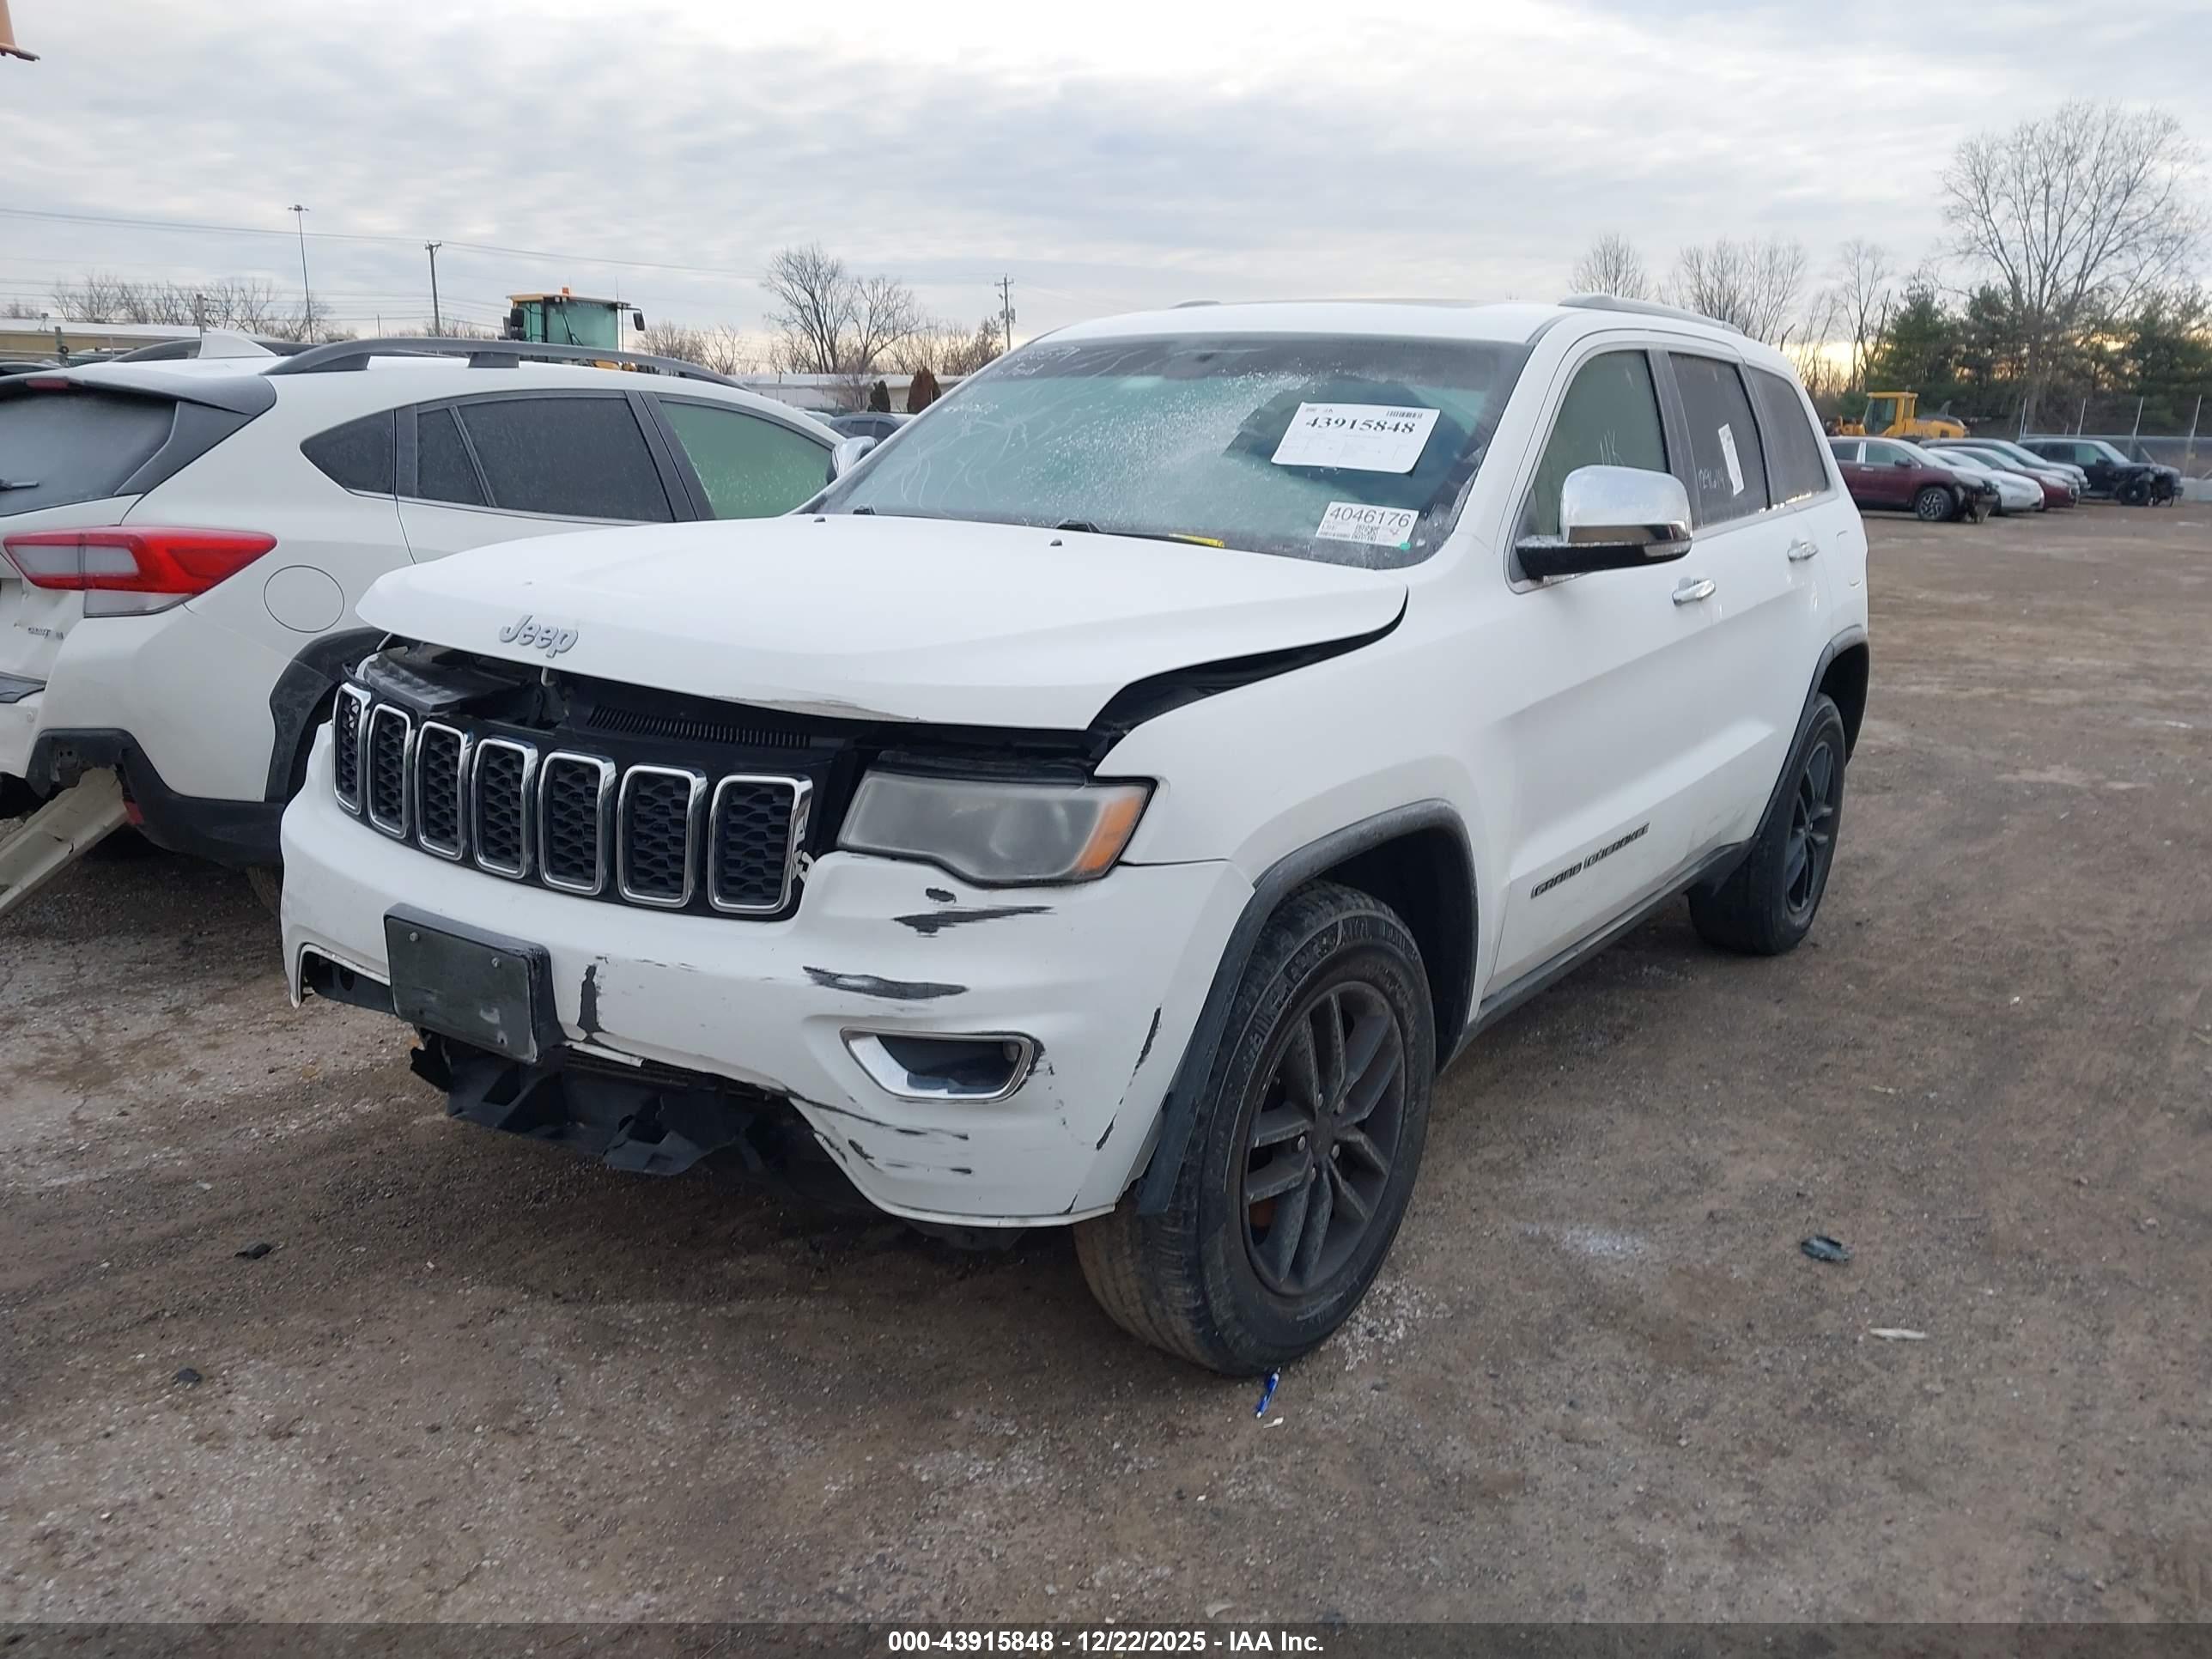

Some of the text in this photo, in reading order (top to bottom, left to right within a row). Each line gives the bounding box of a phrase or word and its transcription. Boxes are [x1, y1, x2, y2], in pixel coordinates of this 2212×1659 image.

[1306, 416, 1416, 434] 43915848
[1329, 507, 1411, 527] 4046176
[499, 615, 579, 659] Jeep
